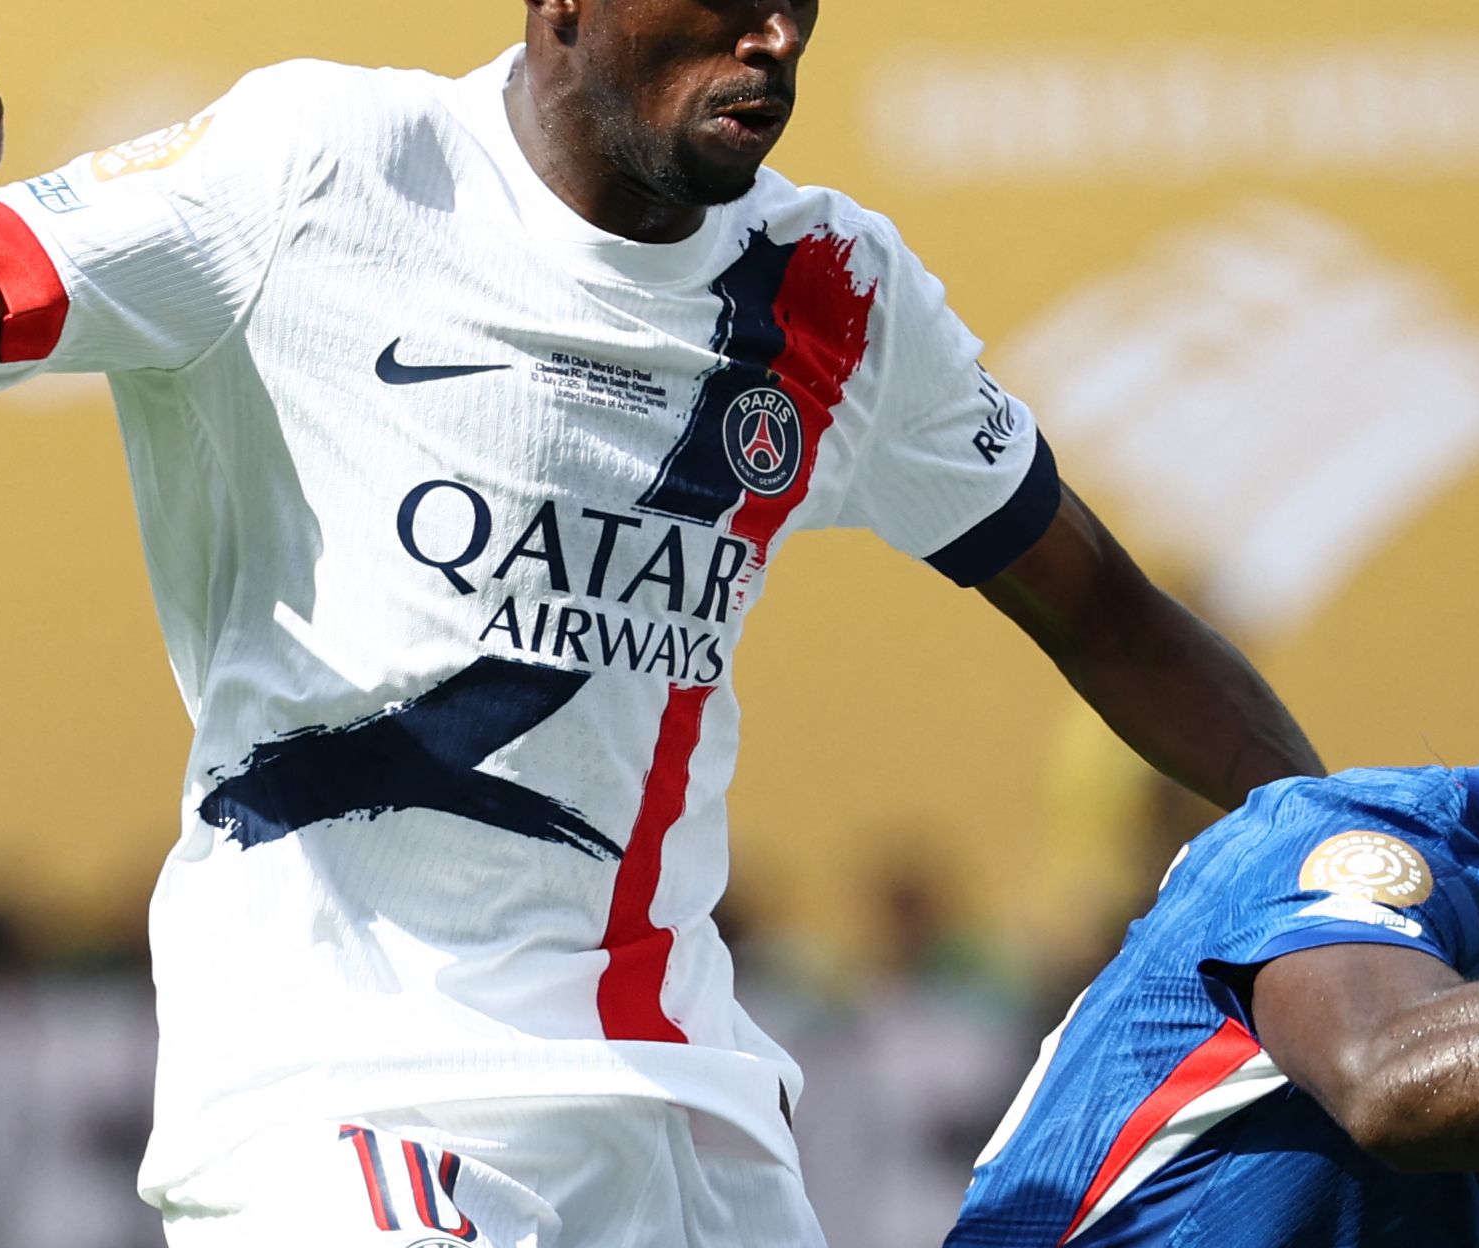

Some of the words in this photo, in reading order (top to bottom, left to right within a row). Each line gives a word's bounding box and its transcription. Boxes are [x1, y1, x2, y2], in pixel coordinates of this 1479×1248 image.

[571, 367, 582, 378] FC
[615, 365, 631, 378] Cup
[738, 393, 792, 423] PARIS
[396, 479, 747, 624] QATAR
[479, 595, 723, 684] AIRWAYS
[1390, 844, 1418, 867] CUP
[1376, 912, 1406, 929] FIFA
